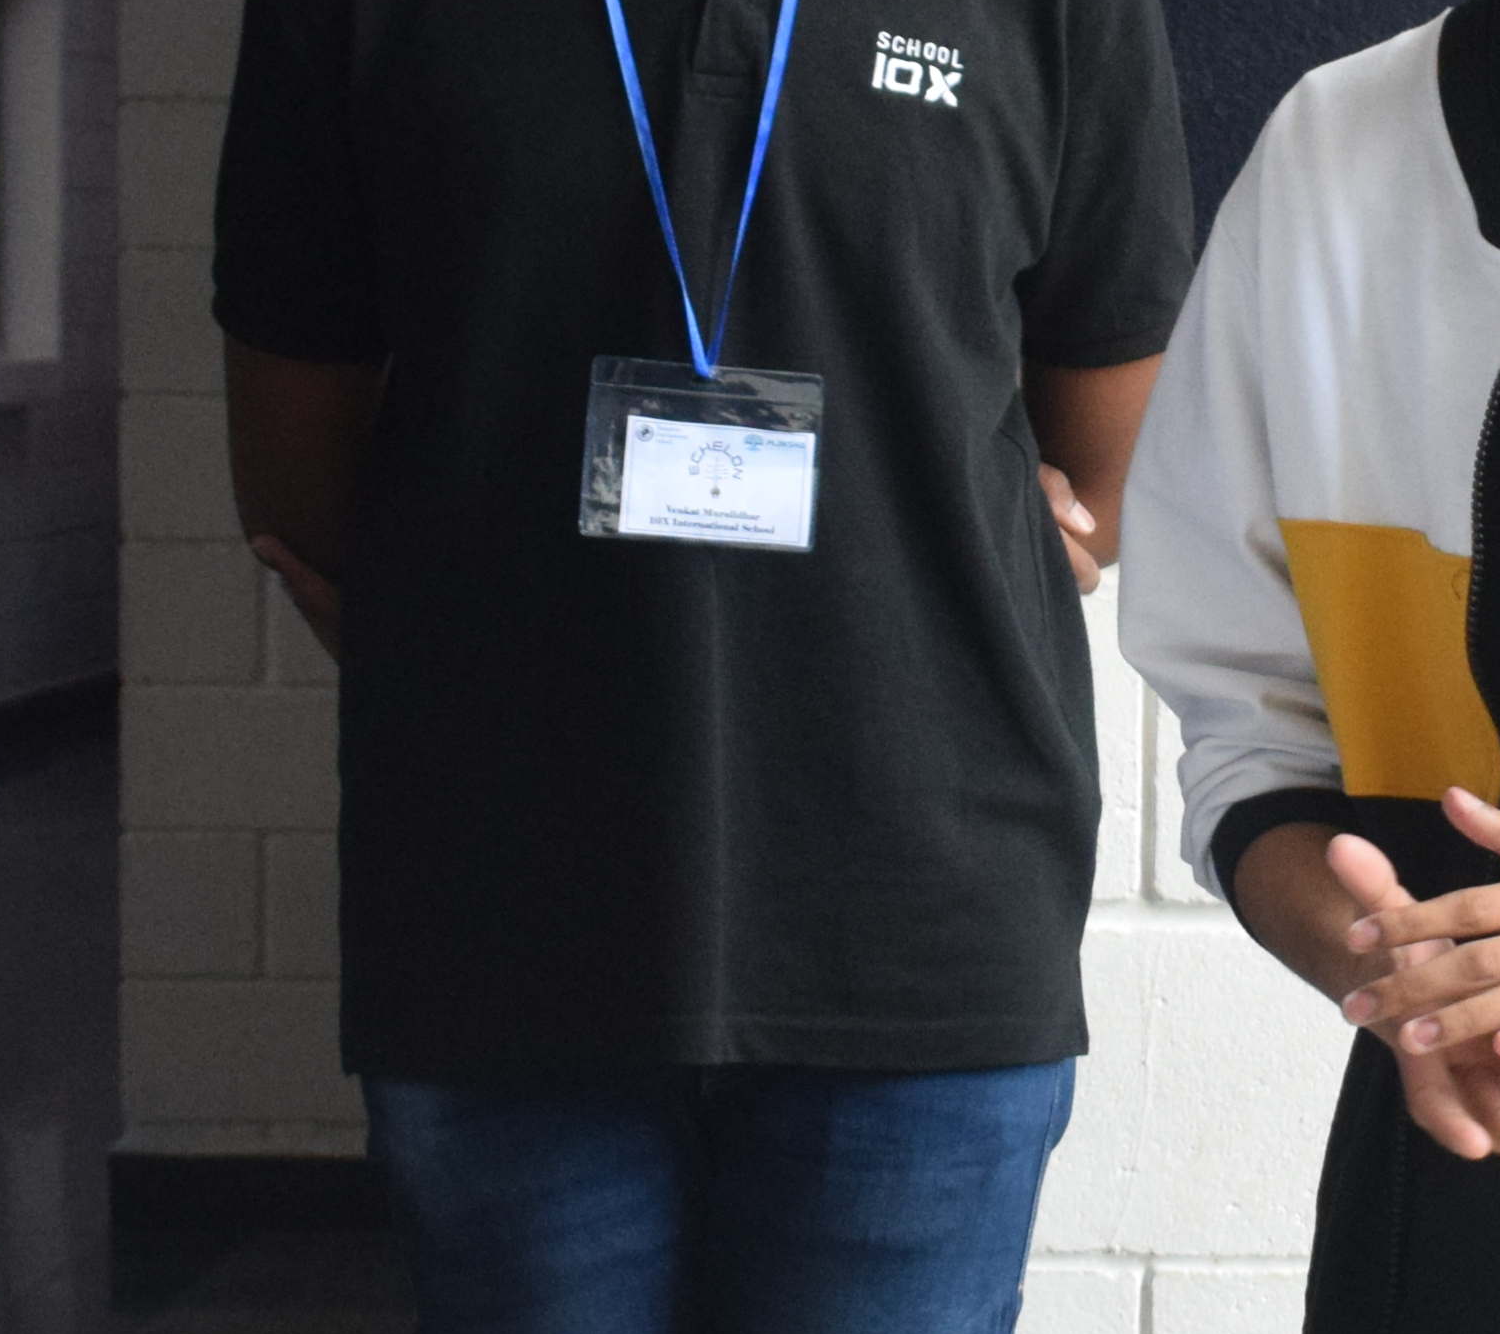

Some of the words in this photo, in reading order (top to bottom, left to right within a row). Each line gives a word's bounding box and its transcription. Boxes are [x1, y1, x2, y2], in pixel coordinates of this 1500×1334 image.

[876, 31, 964, 69] SCHOOL
[688, 440, 744, 480] ECHELON
[673, 518, 739, 533] International
[742, 523, 776, 535] School
